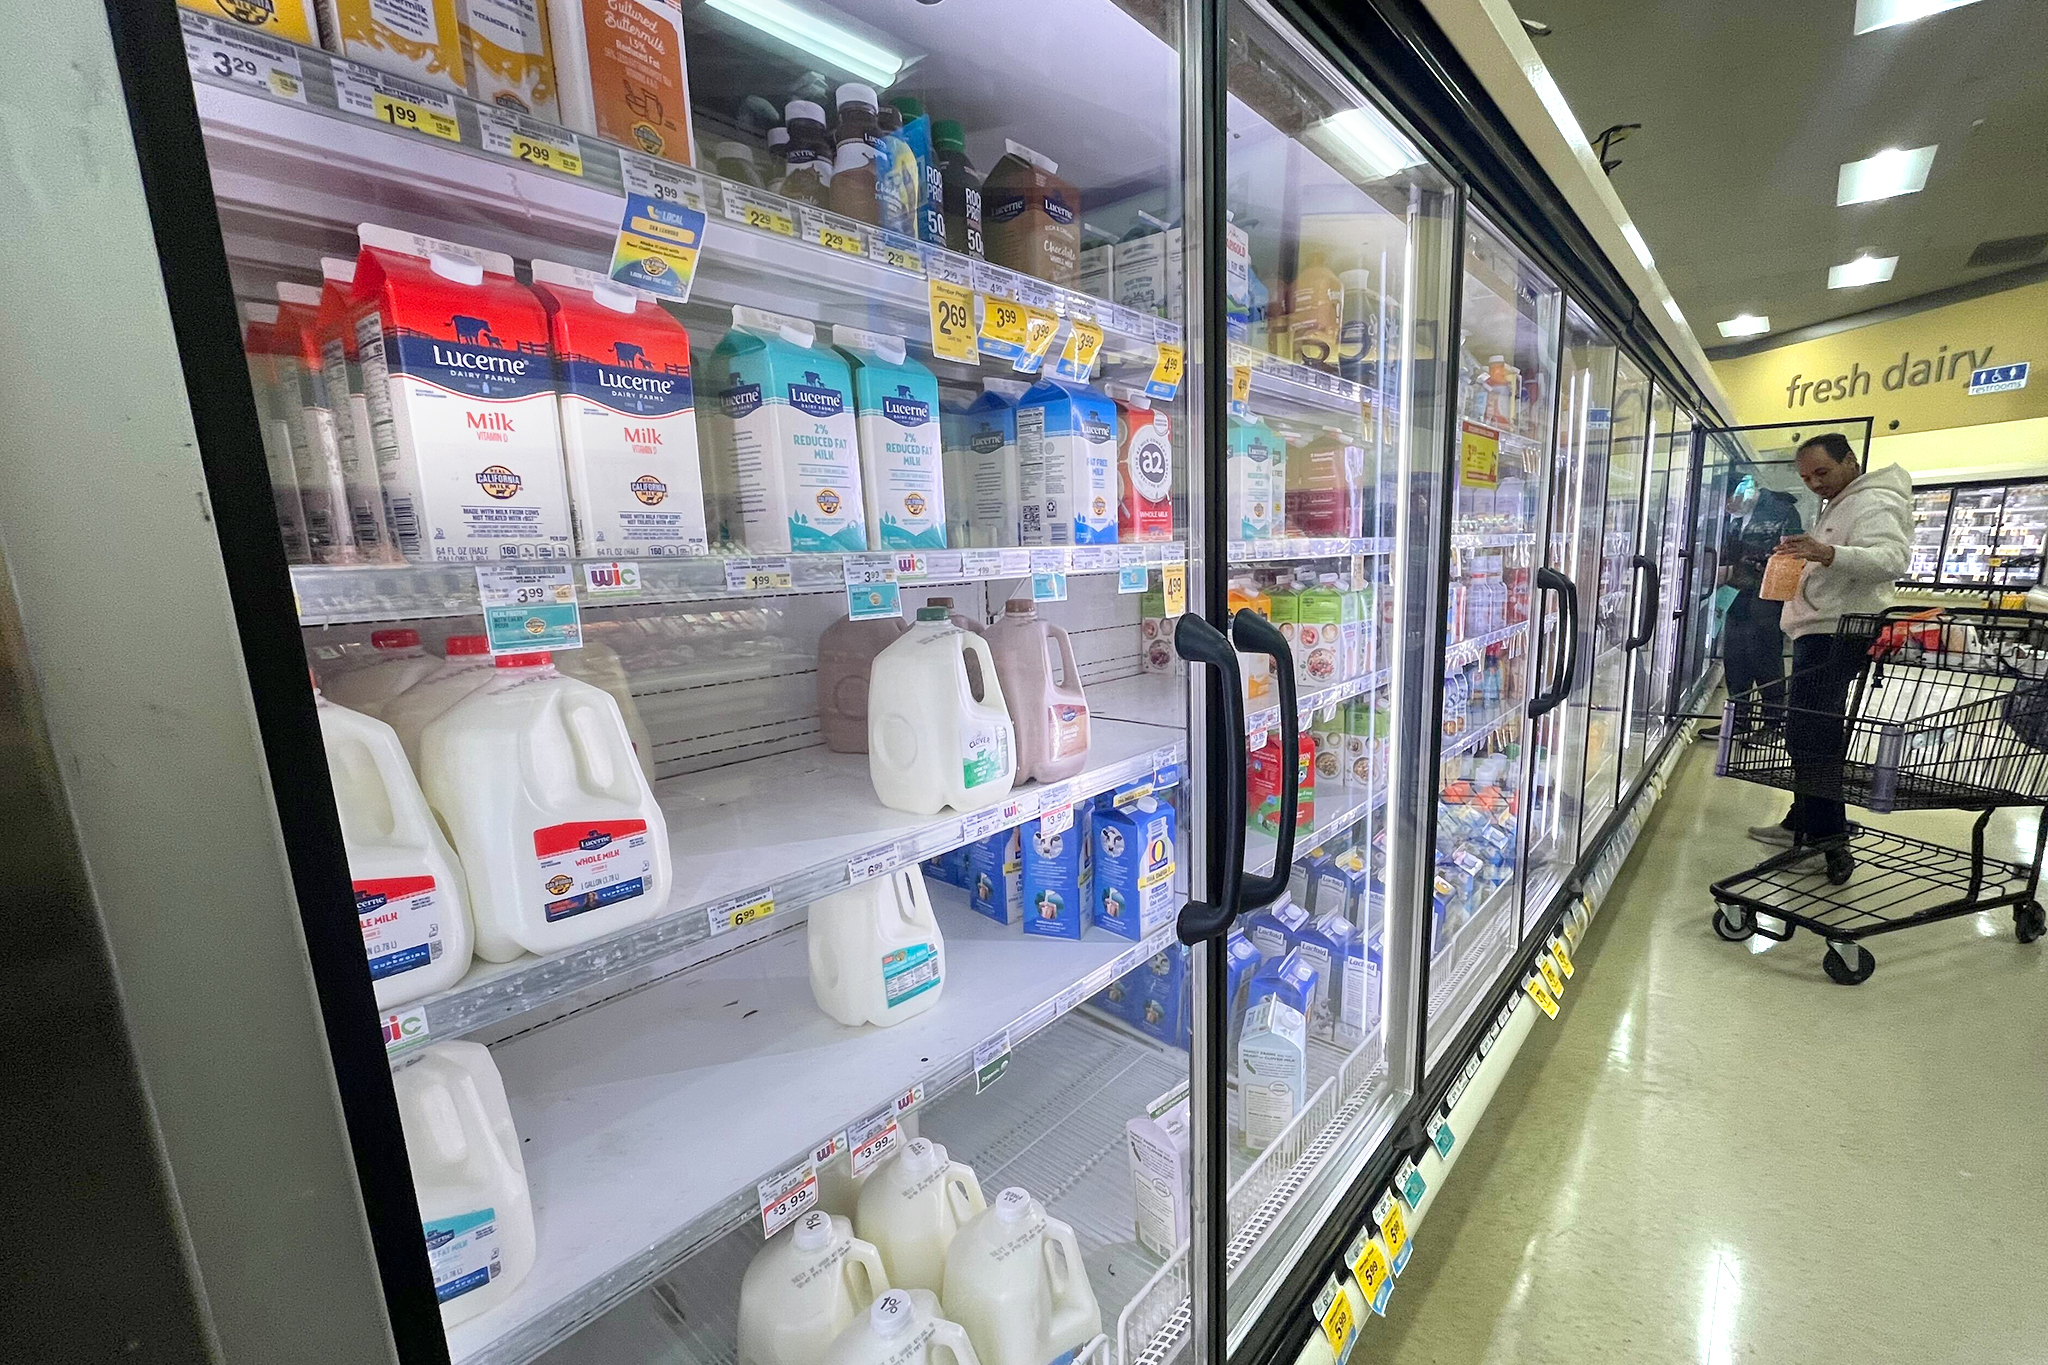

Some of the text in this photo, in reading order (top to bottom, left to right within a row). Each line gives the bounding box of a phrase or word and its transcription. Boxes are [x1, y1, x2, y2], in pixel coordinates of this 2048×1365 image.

[608, 0, 658, 34] Cultured
[604, 11, 665, 55] Buttermilk
[213, 51, 257, 77] 329
[384, 103, 416, 124] 199
[519, 143, 550, 163] 299
[654, 184, 678, 200] 399
[1045, 199, 1073, 220] Lucerne
[1044, 239, 1076, 260] Chocolate
[938, 301, 967, 335] 269
[996, 307, 1016, 328] 399
[433, 345, 526, 376] Lucerne
[450, 369, 516, 384] DAIRY FARMS
[599, 369, 672, 394] Lucerne
[1786, 346, 1994, 409] fresh dairy
[1971, 380, 2022, 394] restrooms
[612, 391, 664, 402] DAIRY FARMS
[792, 388, 840, 407] Lucerne
[886, 401, 928, 417] Lucerne
[466, 411, 515, 432] Milk
[814, 424, 828, 435] 2%
[476, 431, 508, 442] VITAMIN D
[624, 427, 663, 445] Milk
[793, 434, 848, 449] REDUCED FAT
[904, 432, 916, 443] 2%
[814, 450, 834, 460] MILK
[886, 443, 932, 455] REDUCED FAT
[1142, 450, 1163, 473] a2
[477, 473, 520, 485] CALIFORNIA
[632, 483, 666, 492] CALIFORNIA
[436, 547, 446, 556] 64
[447, 547, 456, 556] FL
[458, 547, 467, 556] OZ
[502, 546, 516, 555] 160
[597, 548, 605, 556] 64
[606, 548, 613, 556] FL
[614, 548, 623, 556] OZ
[898, 553, 924, 572] wic
[591, 562, 636, 587] wic
[517, 588, 544, 603] 399
[969, 737, 990, 749] CLOVER
[581, 836, 610, 848] Lucerne
[575, 849, 620, 866] WHOLE MILK
[585, 879, 602, 889] GALLON
[374, 912, 398, 925] MILK
[735, 909, 755, 925] 699
[1259, 927, 1281, 939] Lactaid
[1302, 943, 1327, 956] Lactaid
[981, 1068, 1000, 1083] Organic
[897, 1088, 922, 1110] wic
[817, 1138, 845, 1162] wic
[861, 1136, 889, 1158] $3.99
[914, 1142, 925, 1151] FAT
[773, 1190, 806, 1216] $3.99
[806, 1213, 821, 1230] 1%
[1365, 1261, 1378, 1286] 599
[880, 1296, 901, 1314] 1%
[1335, 1312, 1347, 1339] 599
